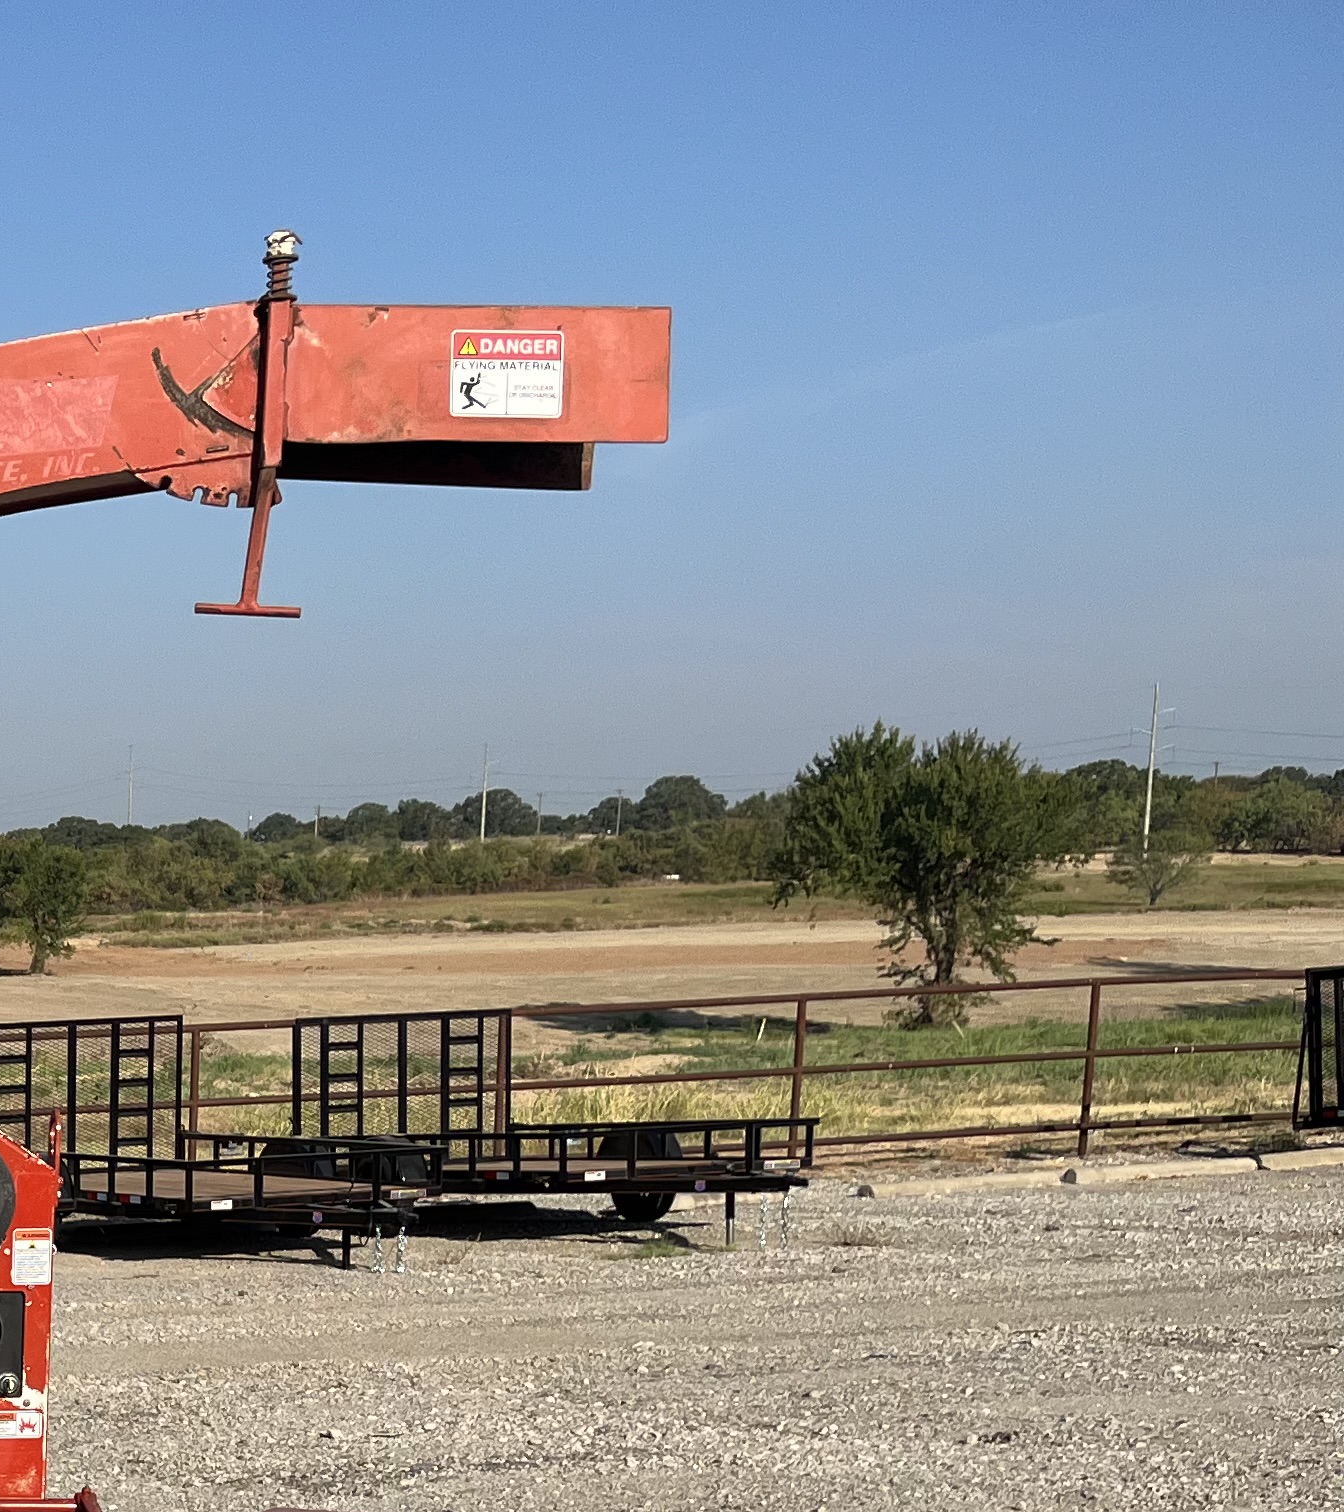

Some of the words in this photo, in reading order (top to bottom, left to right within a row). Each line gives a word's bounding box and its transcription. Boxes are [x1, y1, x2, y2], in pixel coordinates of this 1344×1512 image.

[479, 338, 558, 355] DANGER
[454, 361, 496, 370] FLYING
[499, 361, 558, 371] MATERIAL
[42, 452, 100, 478] INC.
